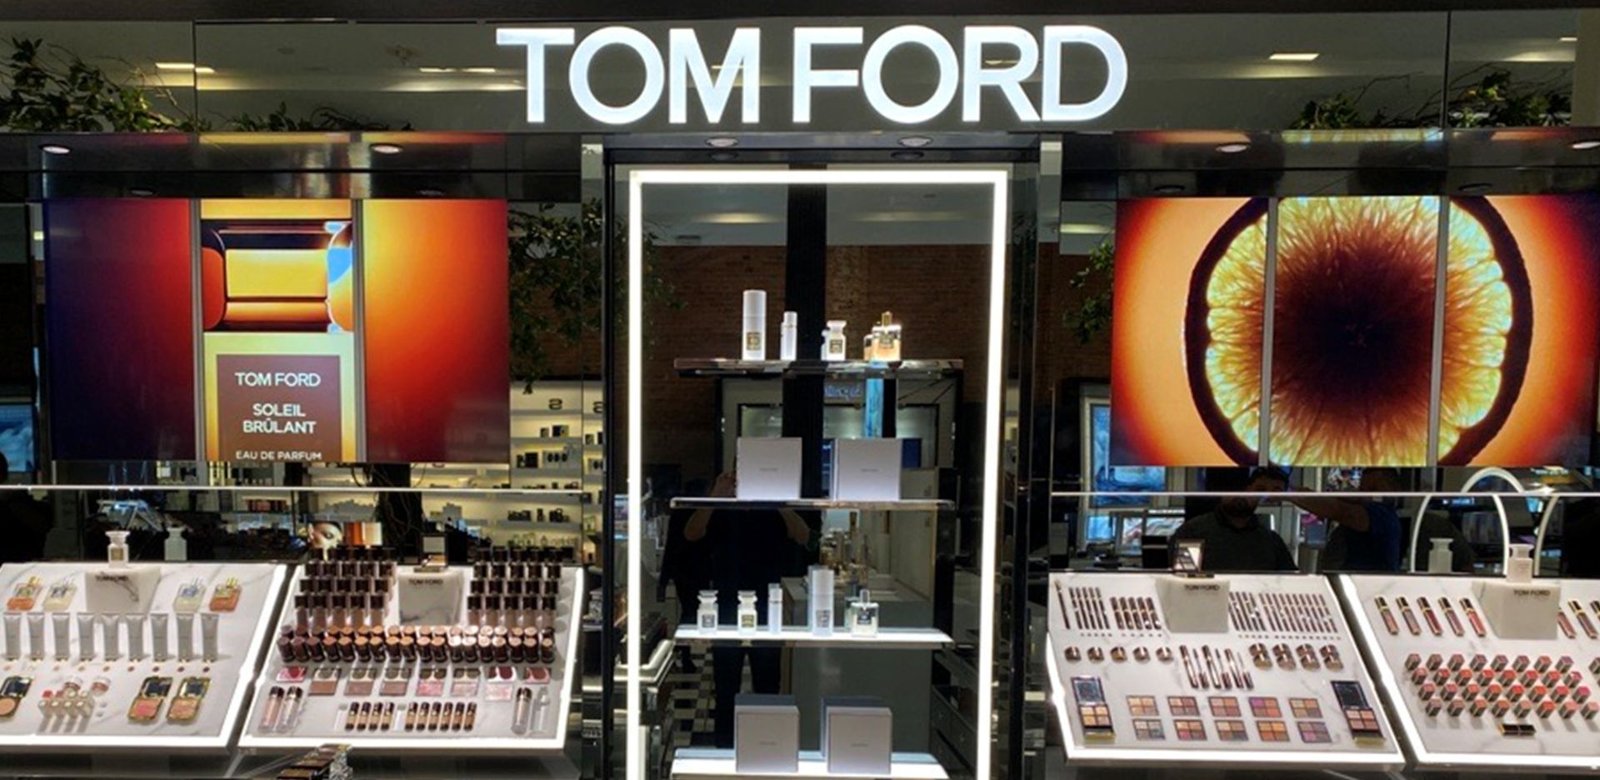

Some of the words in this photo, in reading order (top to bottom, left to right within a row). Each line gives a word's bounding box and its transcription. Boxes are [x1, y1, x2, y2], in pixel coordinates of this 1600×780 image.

[496, 26, 761, 125] TOM
[793, 25, 1128, 124] FORD
[234, 372, 272, 387] TOM
[274, 372, 322, 388] FORD
[252, 403, 307, 417] SOLEIL
[242, 417, 317, 434] BRÛLANT
[235, 450, 259, 460] EAU
[260, 450, 275, 460] DE
[277, 451, 322, 461] PARFUM
